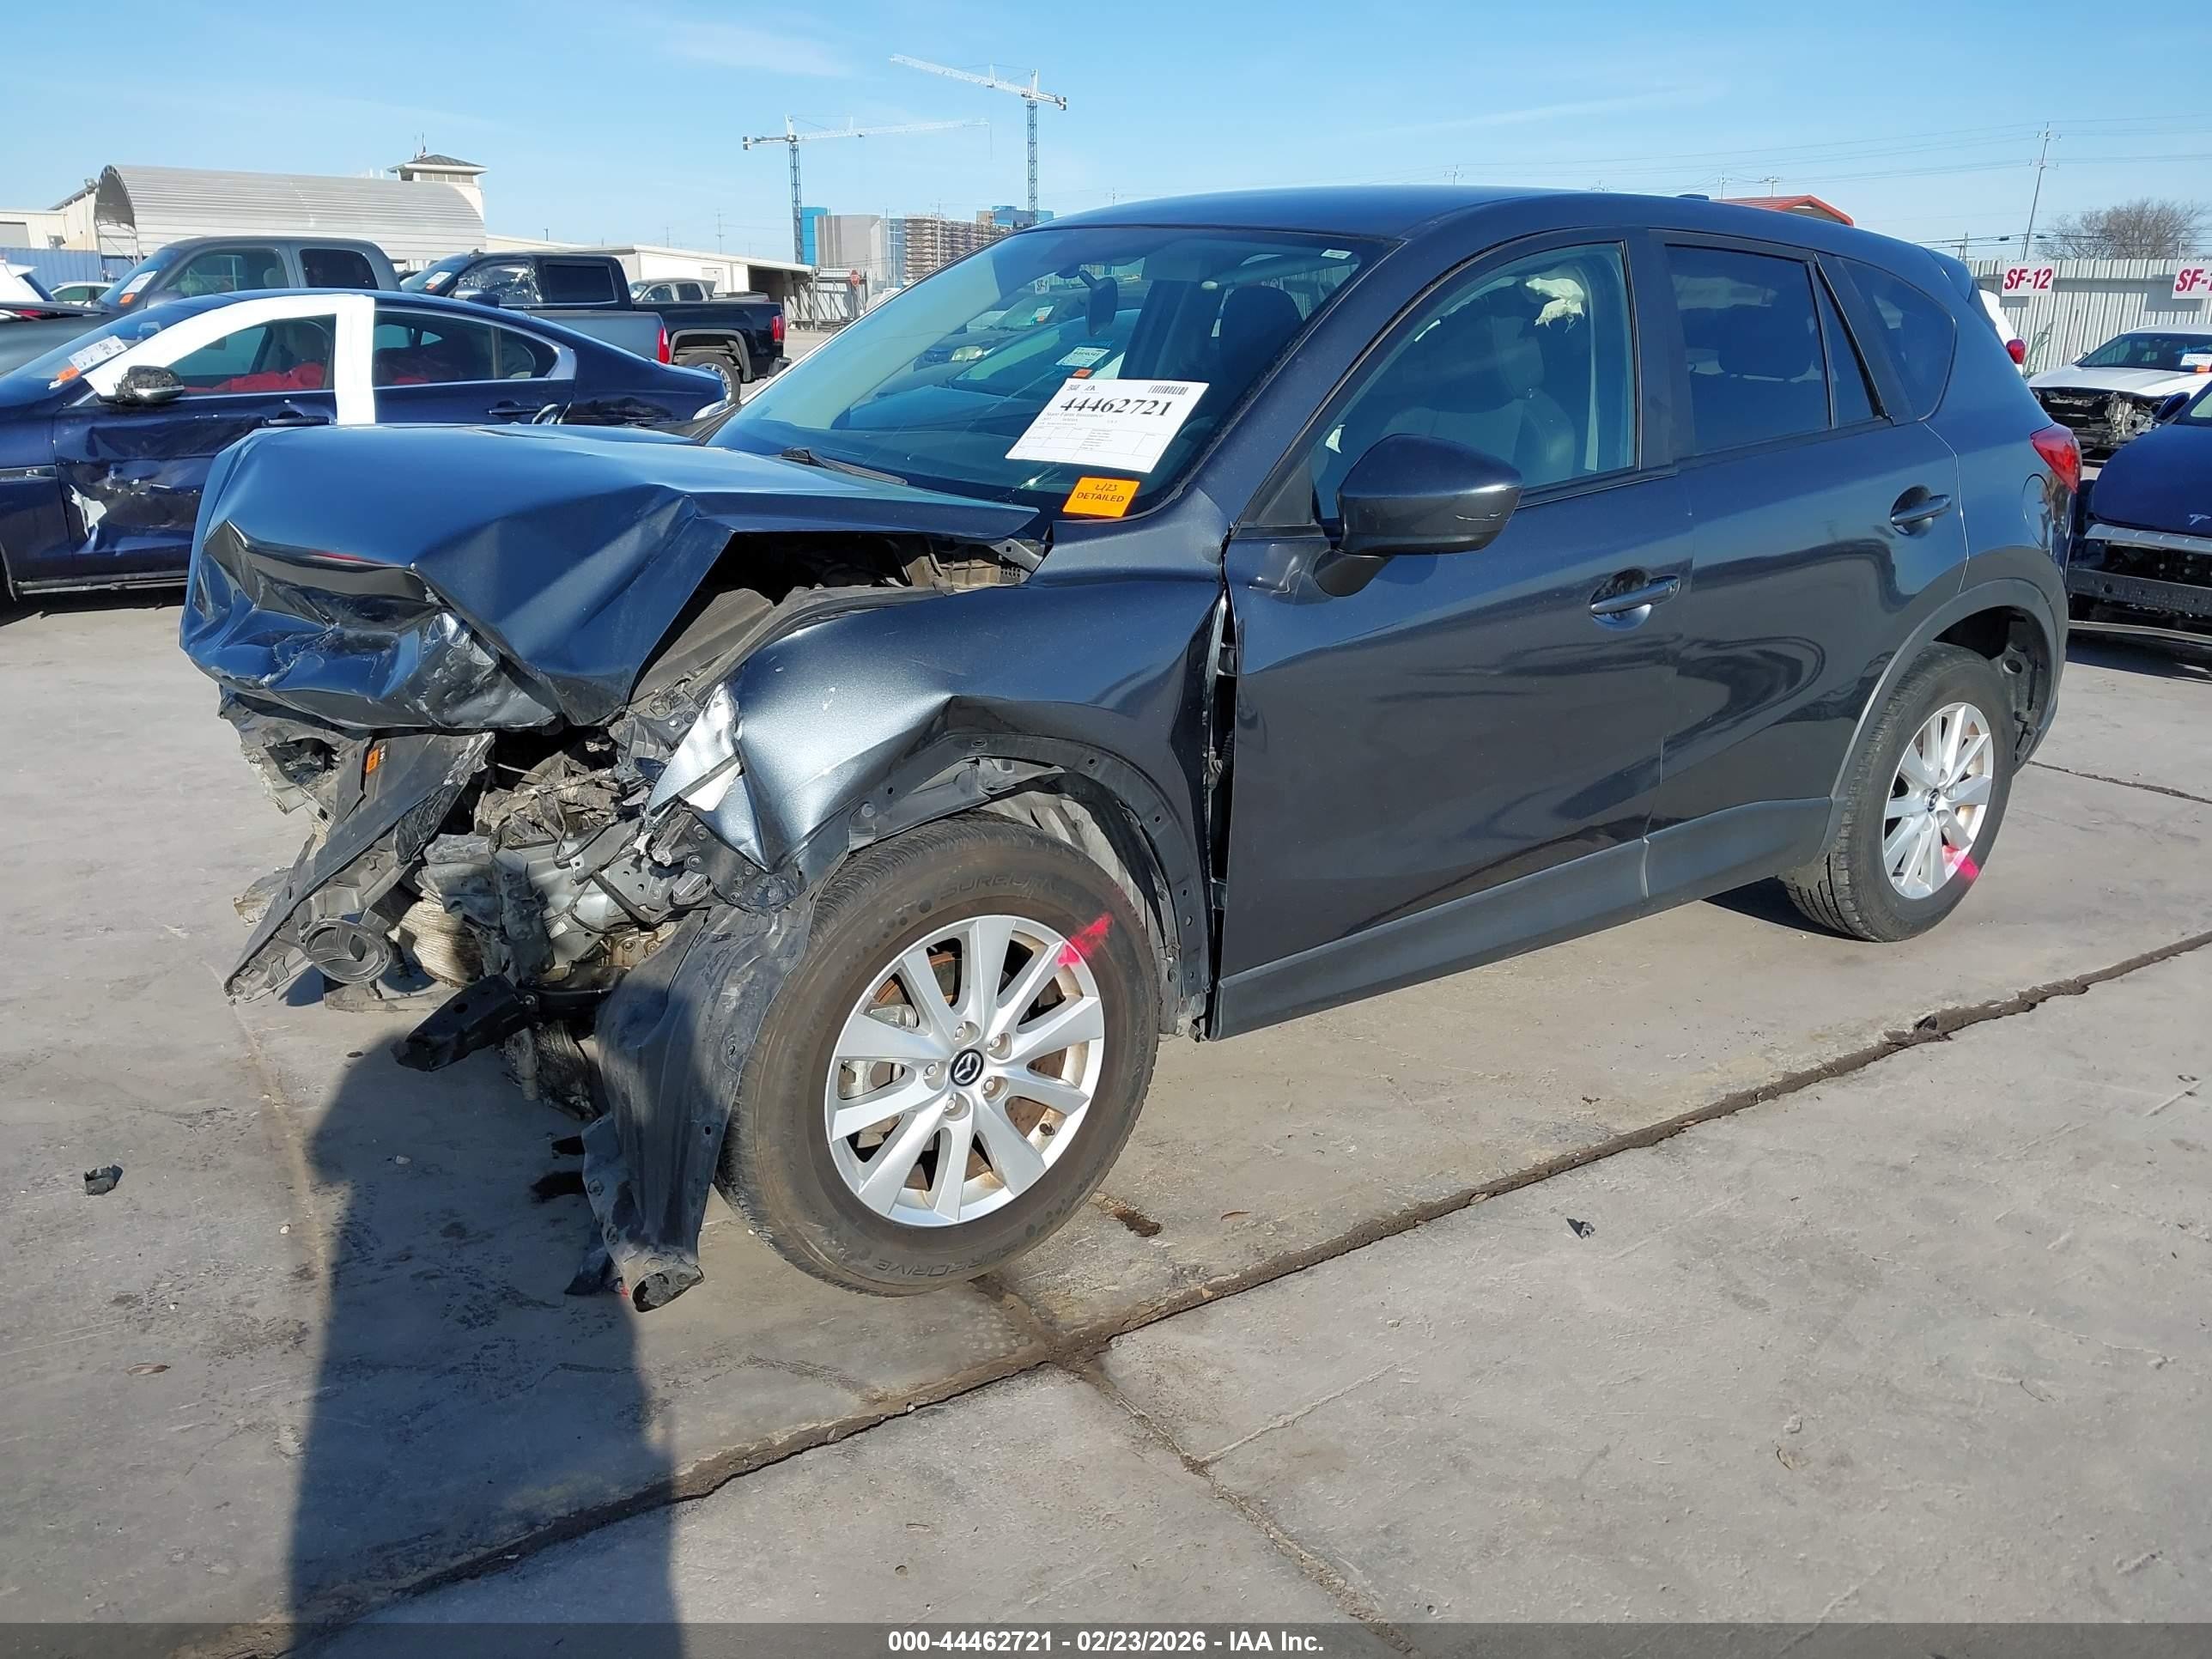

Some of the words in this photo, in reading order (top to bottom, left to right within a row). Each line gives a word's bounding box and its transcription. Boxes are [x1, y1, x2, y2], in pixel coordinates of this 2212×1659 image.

[2003, 268, 2053, 290] SF-12
[1060, 397, 1173, 416] 44462721
[1076, 491, 1125, 502] DETAILED
